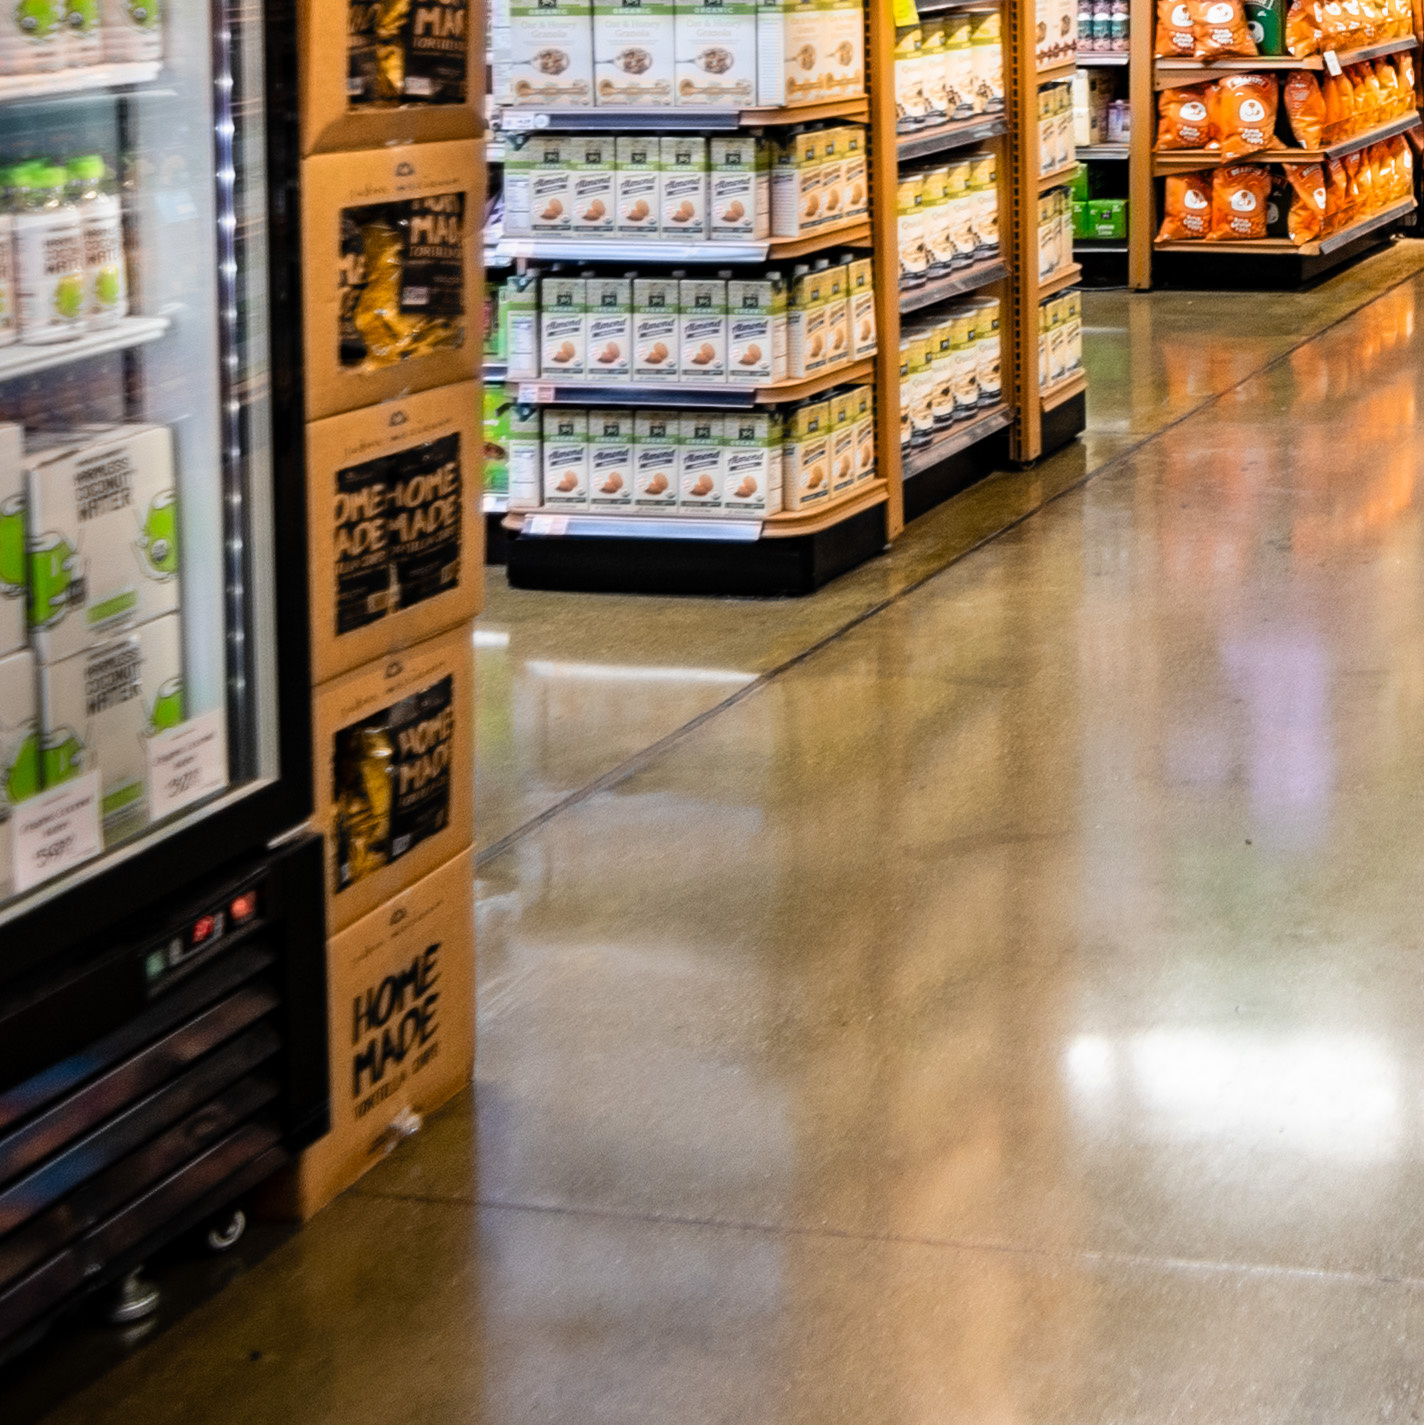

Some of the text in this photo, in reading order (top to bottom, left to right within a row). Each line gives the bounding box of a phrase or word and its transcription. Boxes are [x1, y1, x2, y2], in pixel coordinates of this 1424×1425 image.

[549, 448, 584, 461] Almond
[594, 449, 629, 463] Almond
[639, 449, 675, 463] Almond
[684, 450, 720, 465] Almond
[728, 453, 764, 467] Almond
[353, 940, 442, 1043] HOME
[353, 991, 440, 1100] MADE
